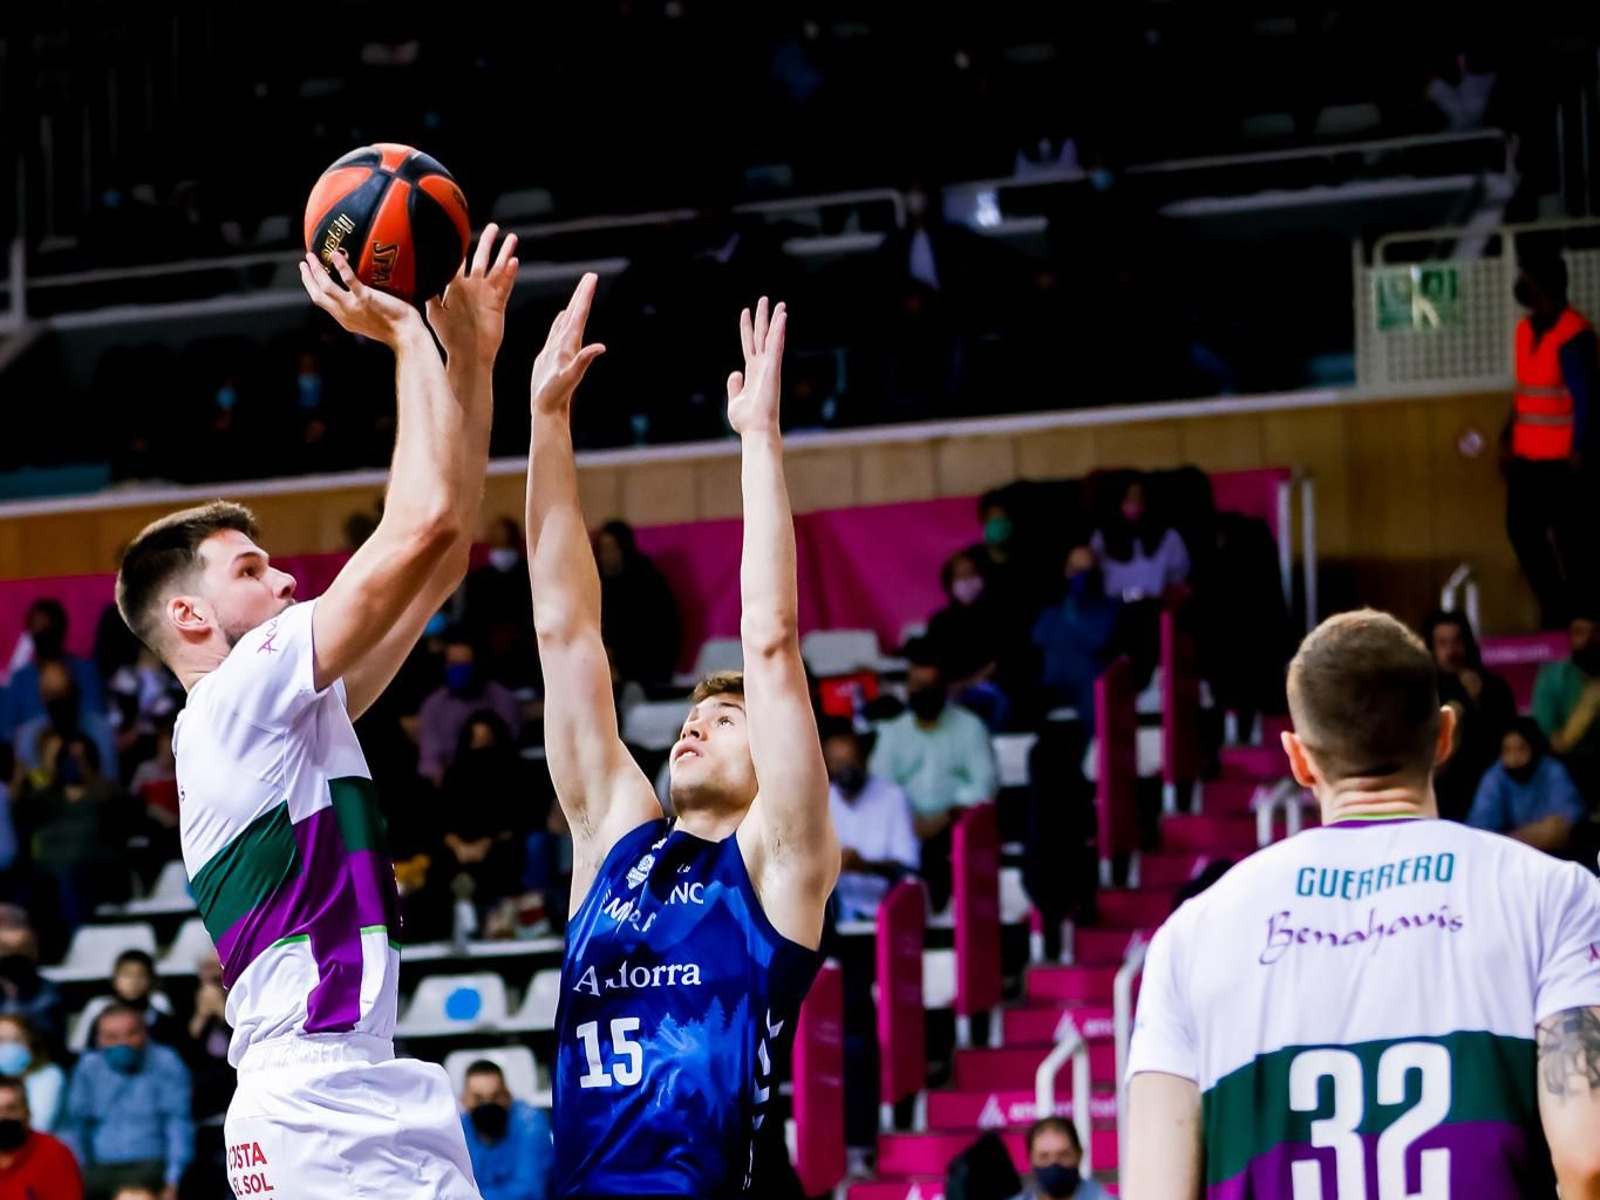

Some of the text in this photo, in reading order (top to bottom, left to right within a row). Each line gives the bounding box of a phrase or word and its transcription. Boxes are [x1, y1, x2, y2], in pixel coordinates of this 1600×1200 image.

[1296, 853, 1455, 900] GUERRERO
[576, 1017, 643, 1088] 15
[242, 1172, 275, 1195] SOL
